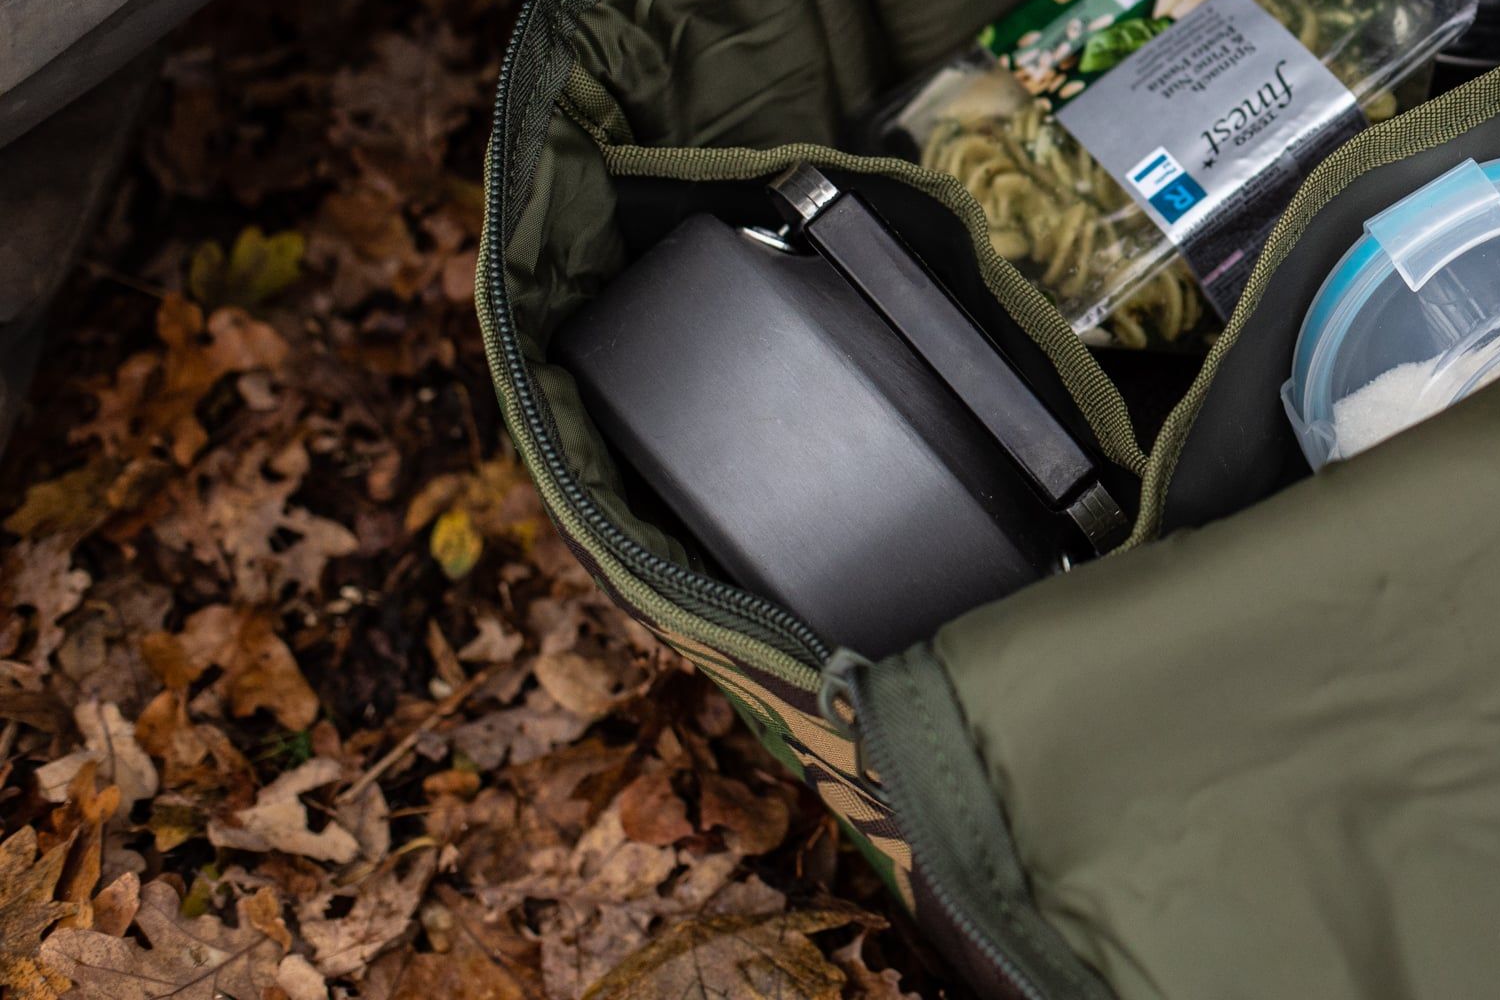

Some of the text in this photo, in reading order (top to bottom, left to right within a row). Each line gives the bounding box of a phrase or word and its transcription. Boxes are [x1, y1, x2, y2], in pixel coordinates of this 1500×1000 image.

[1191, 43, 1256, 93] Spinach
[1194, 43, 1231, 69] Pine
[1147, 58, 1192, 92] Pasta
[1161, 76, 1194, 100] Nut
[1201, 60, 1293, 155] finest
[1234, 110, 1279, 147] TESCO
